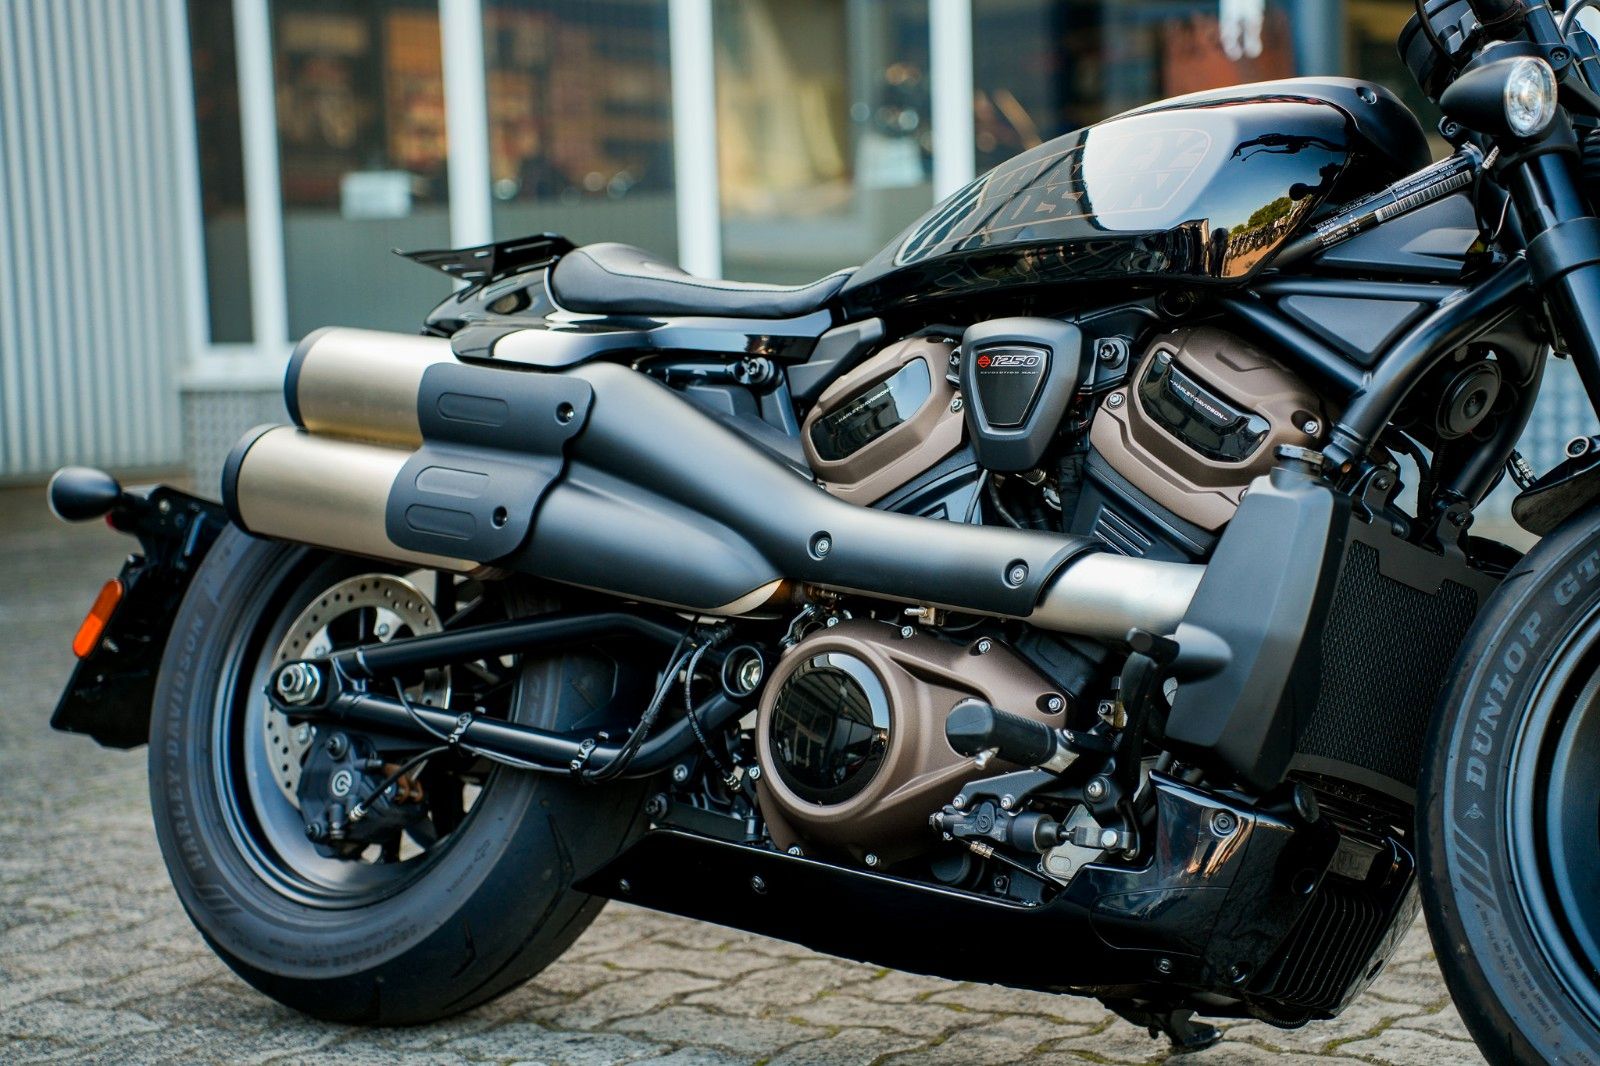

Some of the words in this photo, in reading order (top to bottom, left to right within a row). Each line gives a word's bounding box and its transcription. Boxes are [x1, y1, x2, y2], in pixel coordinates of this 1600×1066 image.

[990, 355, 1041, 367] 1250
[1173, 380, 1224, 419] HARLEY-DAVIDSON
[1465, 611, 1542, 791] DUNLOP
